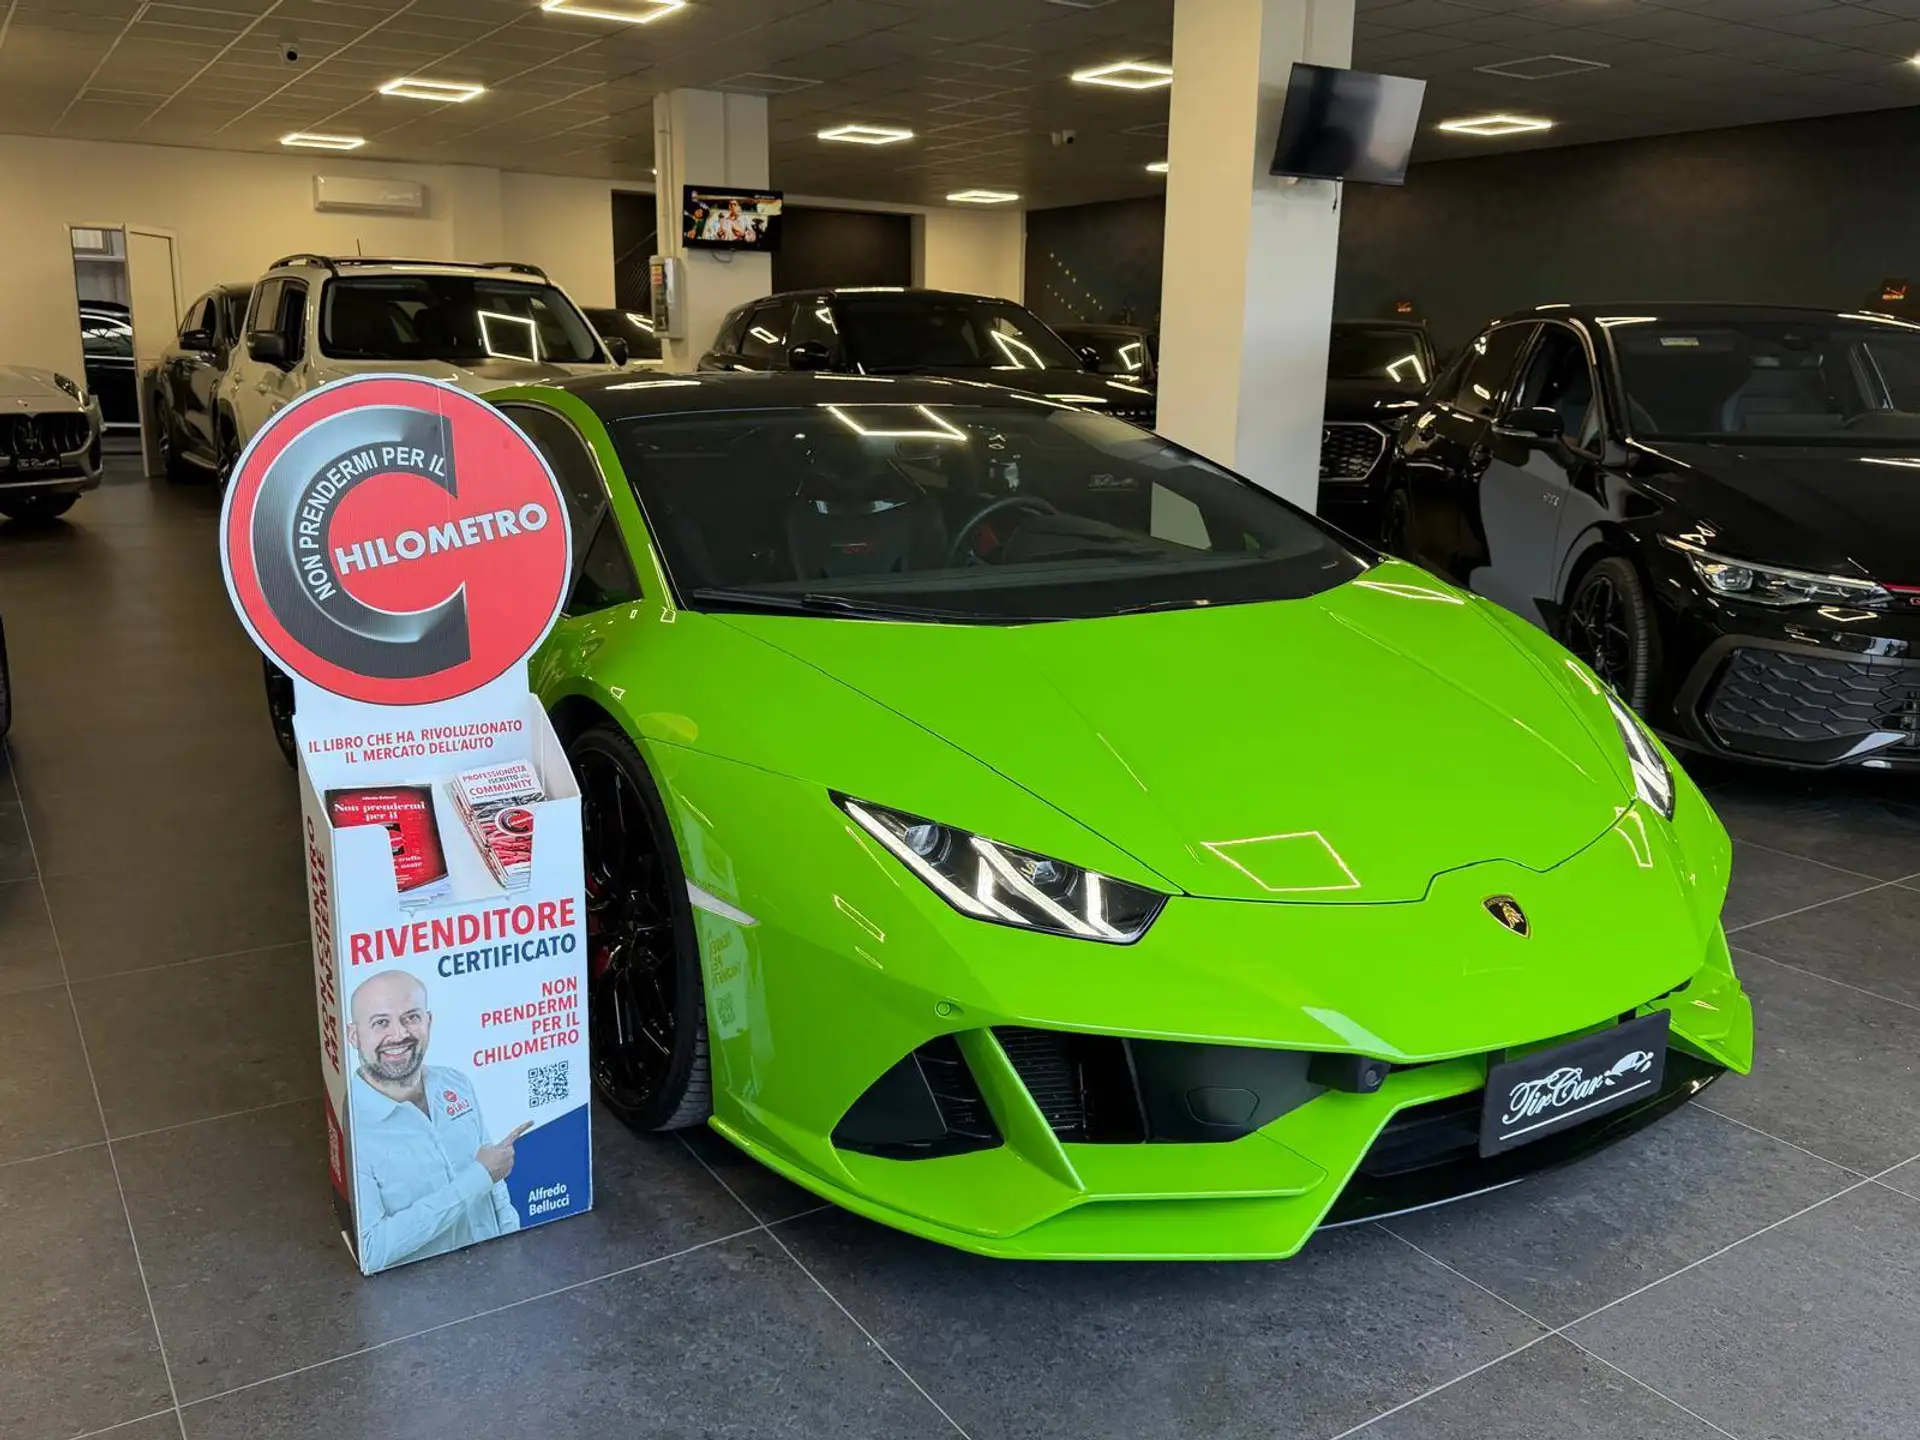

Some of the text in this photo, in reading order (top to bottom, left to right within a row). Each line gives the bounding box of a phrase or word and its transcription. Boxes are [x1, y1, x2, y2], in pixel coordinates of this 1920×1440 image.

[299, 447, 445, 600] NON PRENDERMI PER IL
[308, 719, 523, 753] IL LIBRO CHE HA RIVOLUZIONATO
[346, 736, 494, 764] IL MERCATO DELL'AUTO
[463, 765, 527, 782] PROFESSIONISTA
[469, 779, 532, 796] COMMUNITY
[334, 801, 425, 814] Non prendermi
[365, 813, 386, 822] per
[350, 898, 575, 966] RIVENDITORE
[437, 933, 577, 978] CERTIFICATO
[541, 976, 577, 997] NON
[481, 994, 578, 1028] PRENDERMI
[532, 1011, 580, 1035] PER IL
[473, 1029, 579, 1067] CHILOMETRO
[528, 1183, 567, 1203] Alfredo
[528, 1194, 570, 1216] Bellucci
